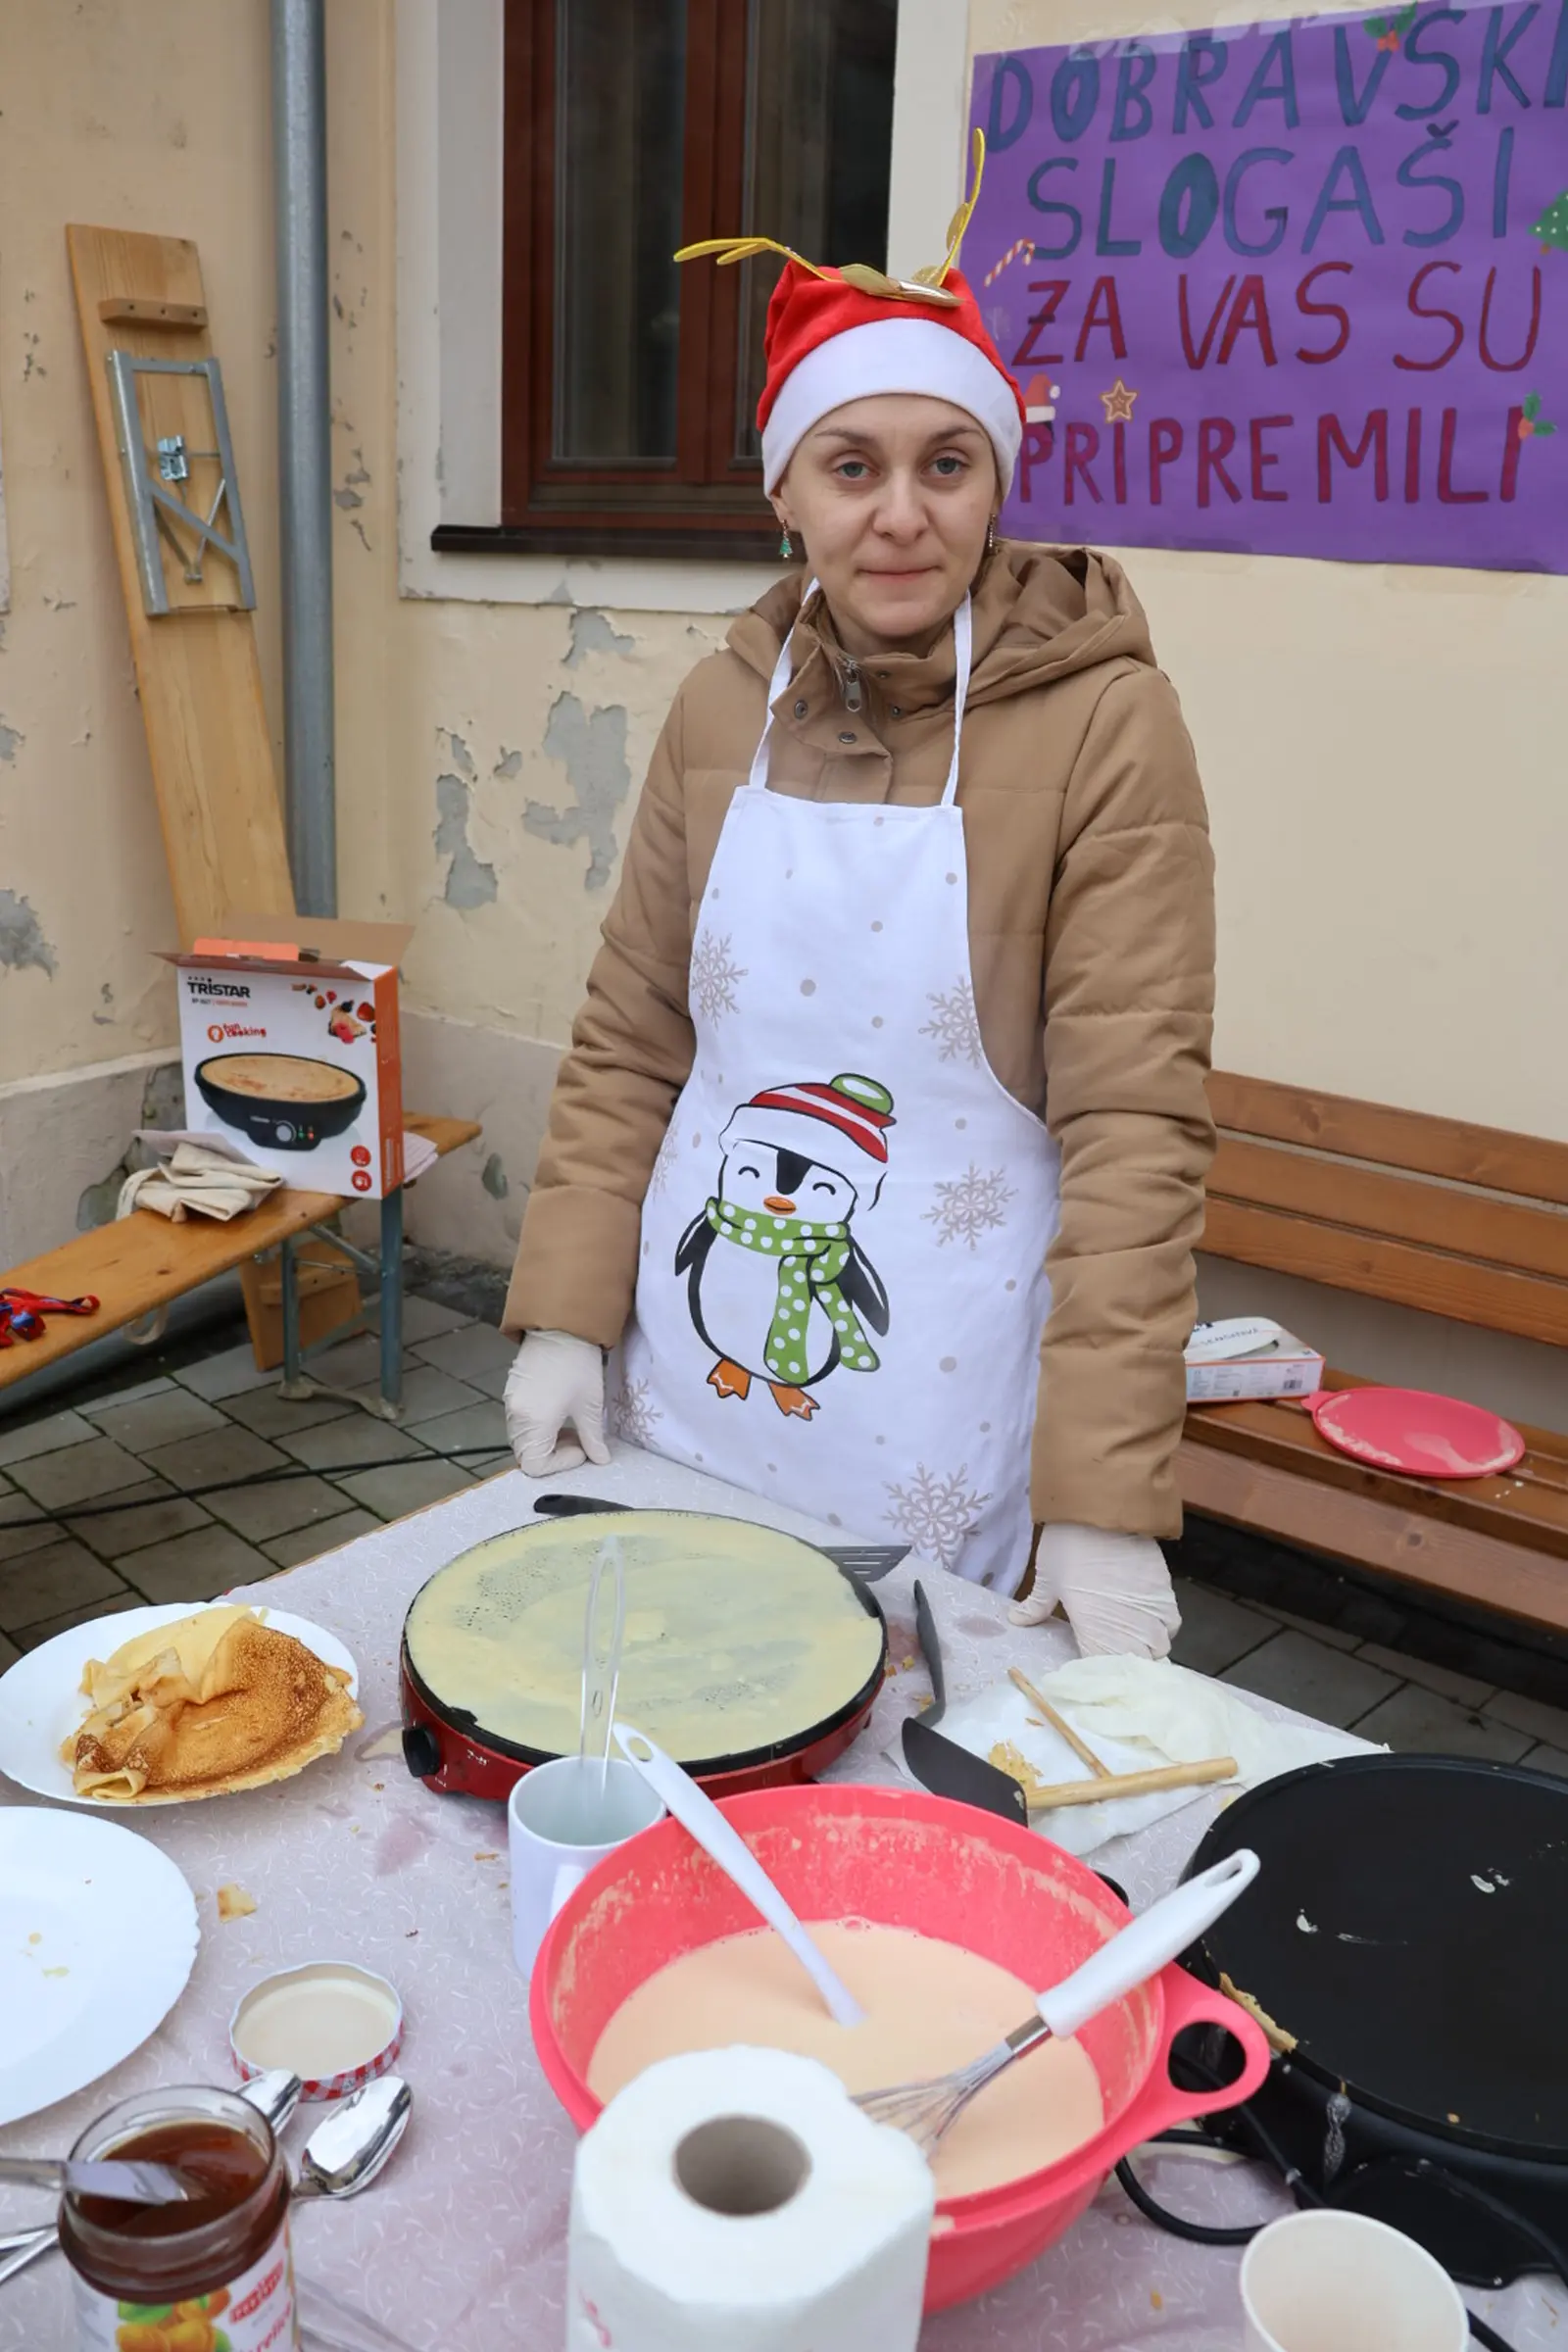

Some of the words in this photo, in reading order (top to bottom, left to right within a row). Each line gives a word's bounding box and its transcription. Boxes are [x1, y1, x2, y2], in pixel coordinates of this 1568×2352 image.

[1026, 121, 1514, 261] SLOGAŠI
[1011, 275, 1128, 367] ZA
[1178, 261, 1353, 371] VAS
[1393, 261, 1542, 372] SU
[1018, 406, 1524, 509] PRIPREMILI
[187, 978, 251, 999] TRISTAR
